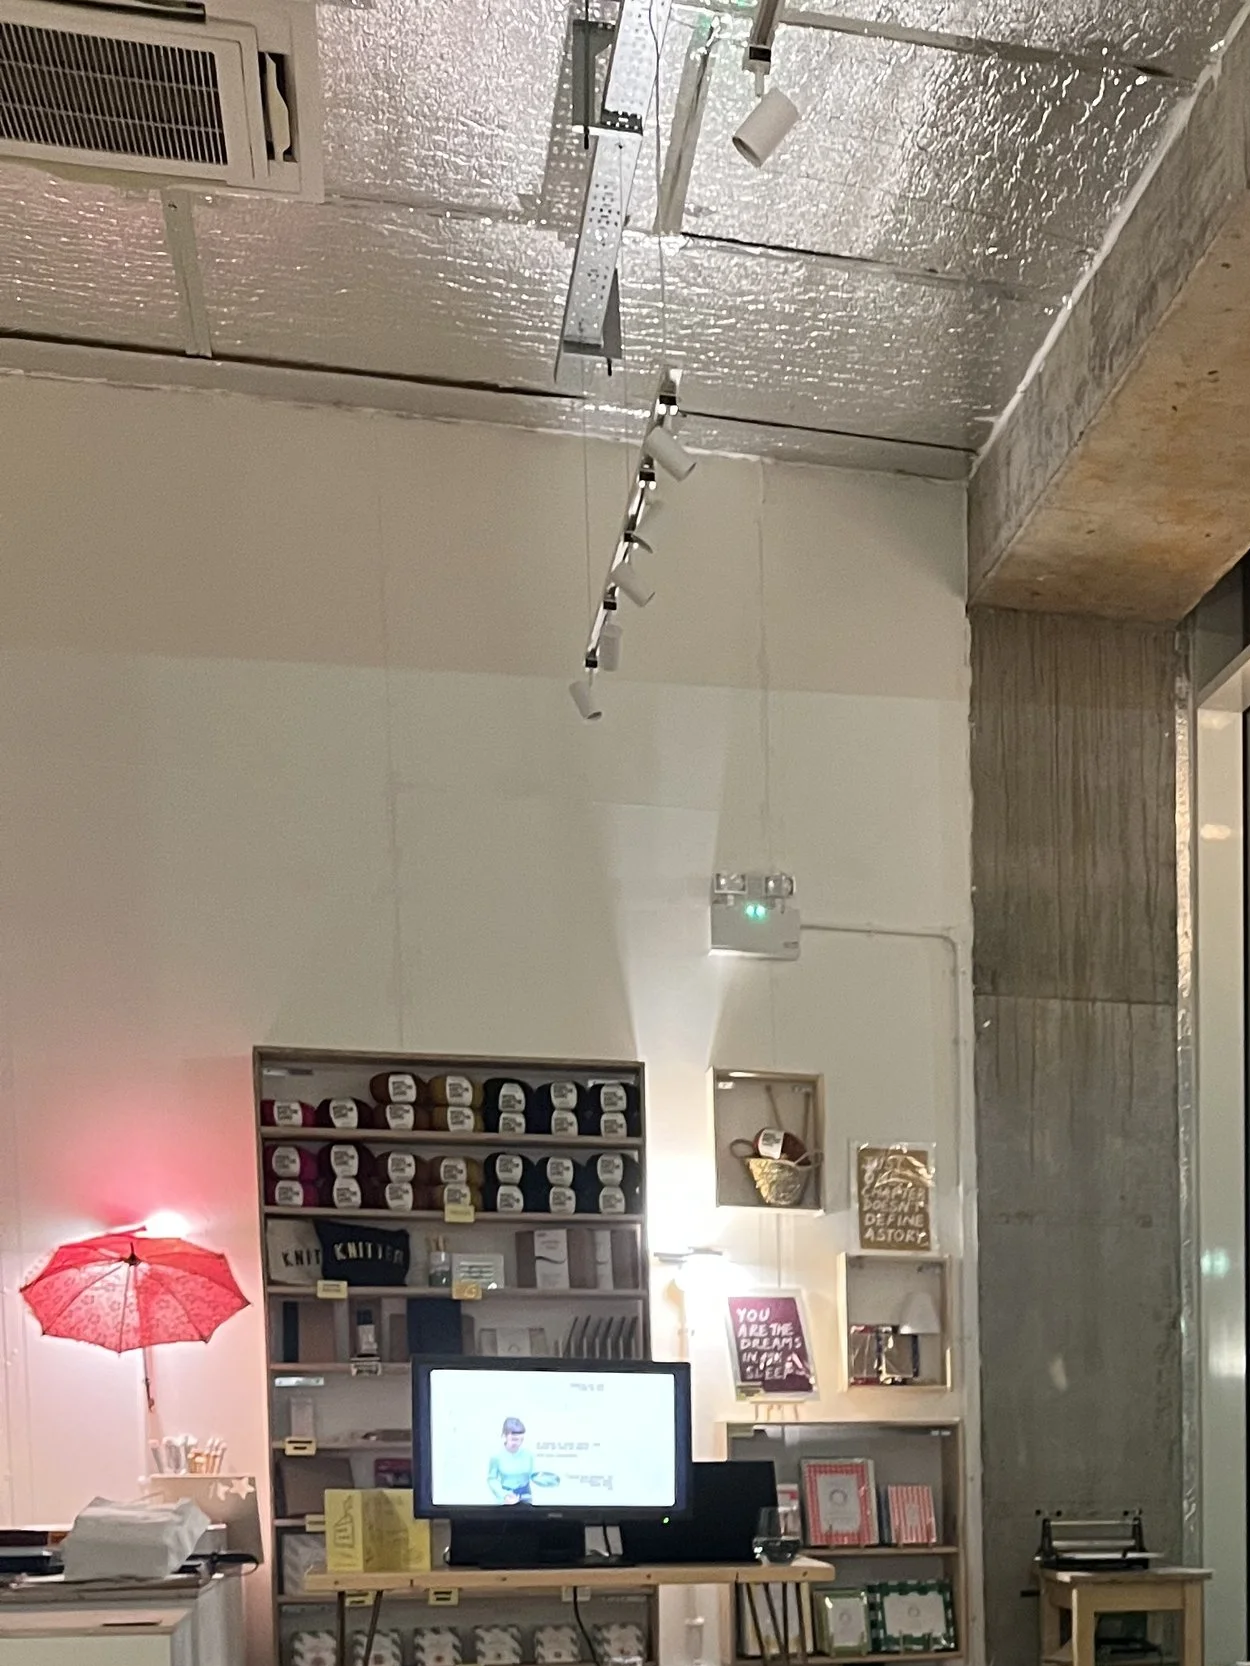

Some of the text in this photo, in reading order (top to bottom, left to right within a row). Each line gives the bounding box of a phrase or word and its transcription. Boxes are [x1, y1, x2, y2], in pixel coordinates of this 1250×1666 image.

[864, 1213, 924, 1228] DEFINE
[736, 1307, 770, 1322] YOU
[738, 1322, 794, 1338] ARE THE
[740, 1336, 802, 1350] DREAMS
